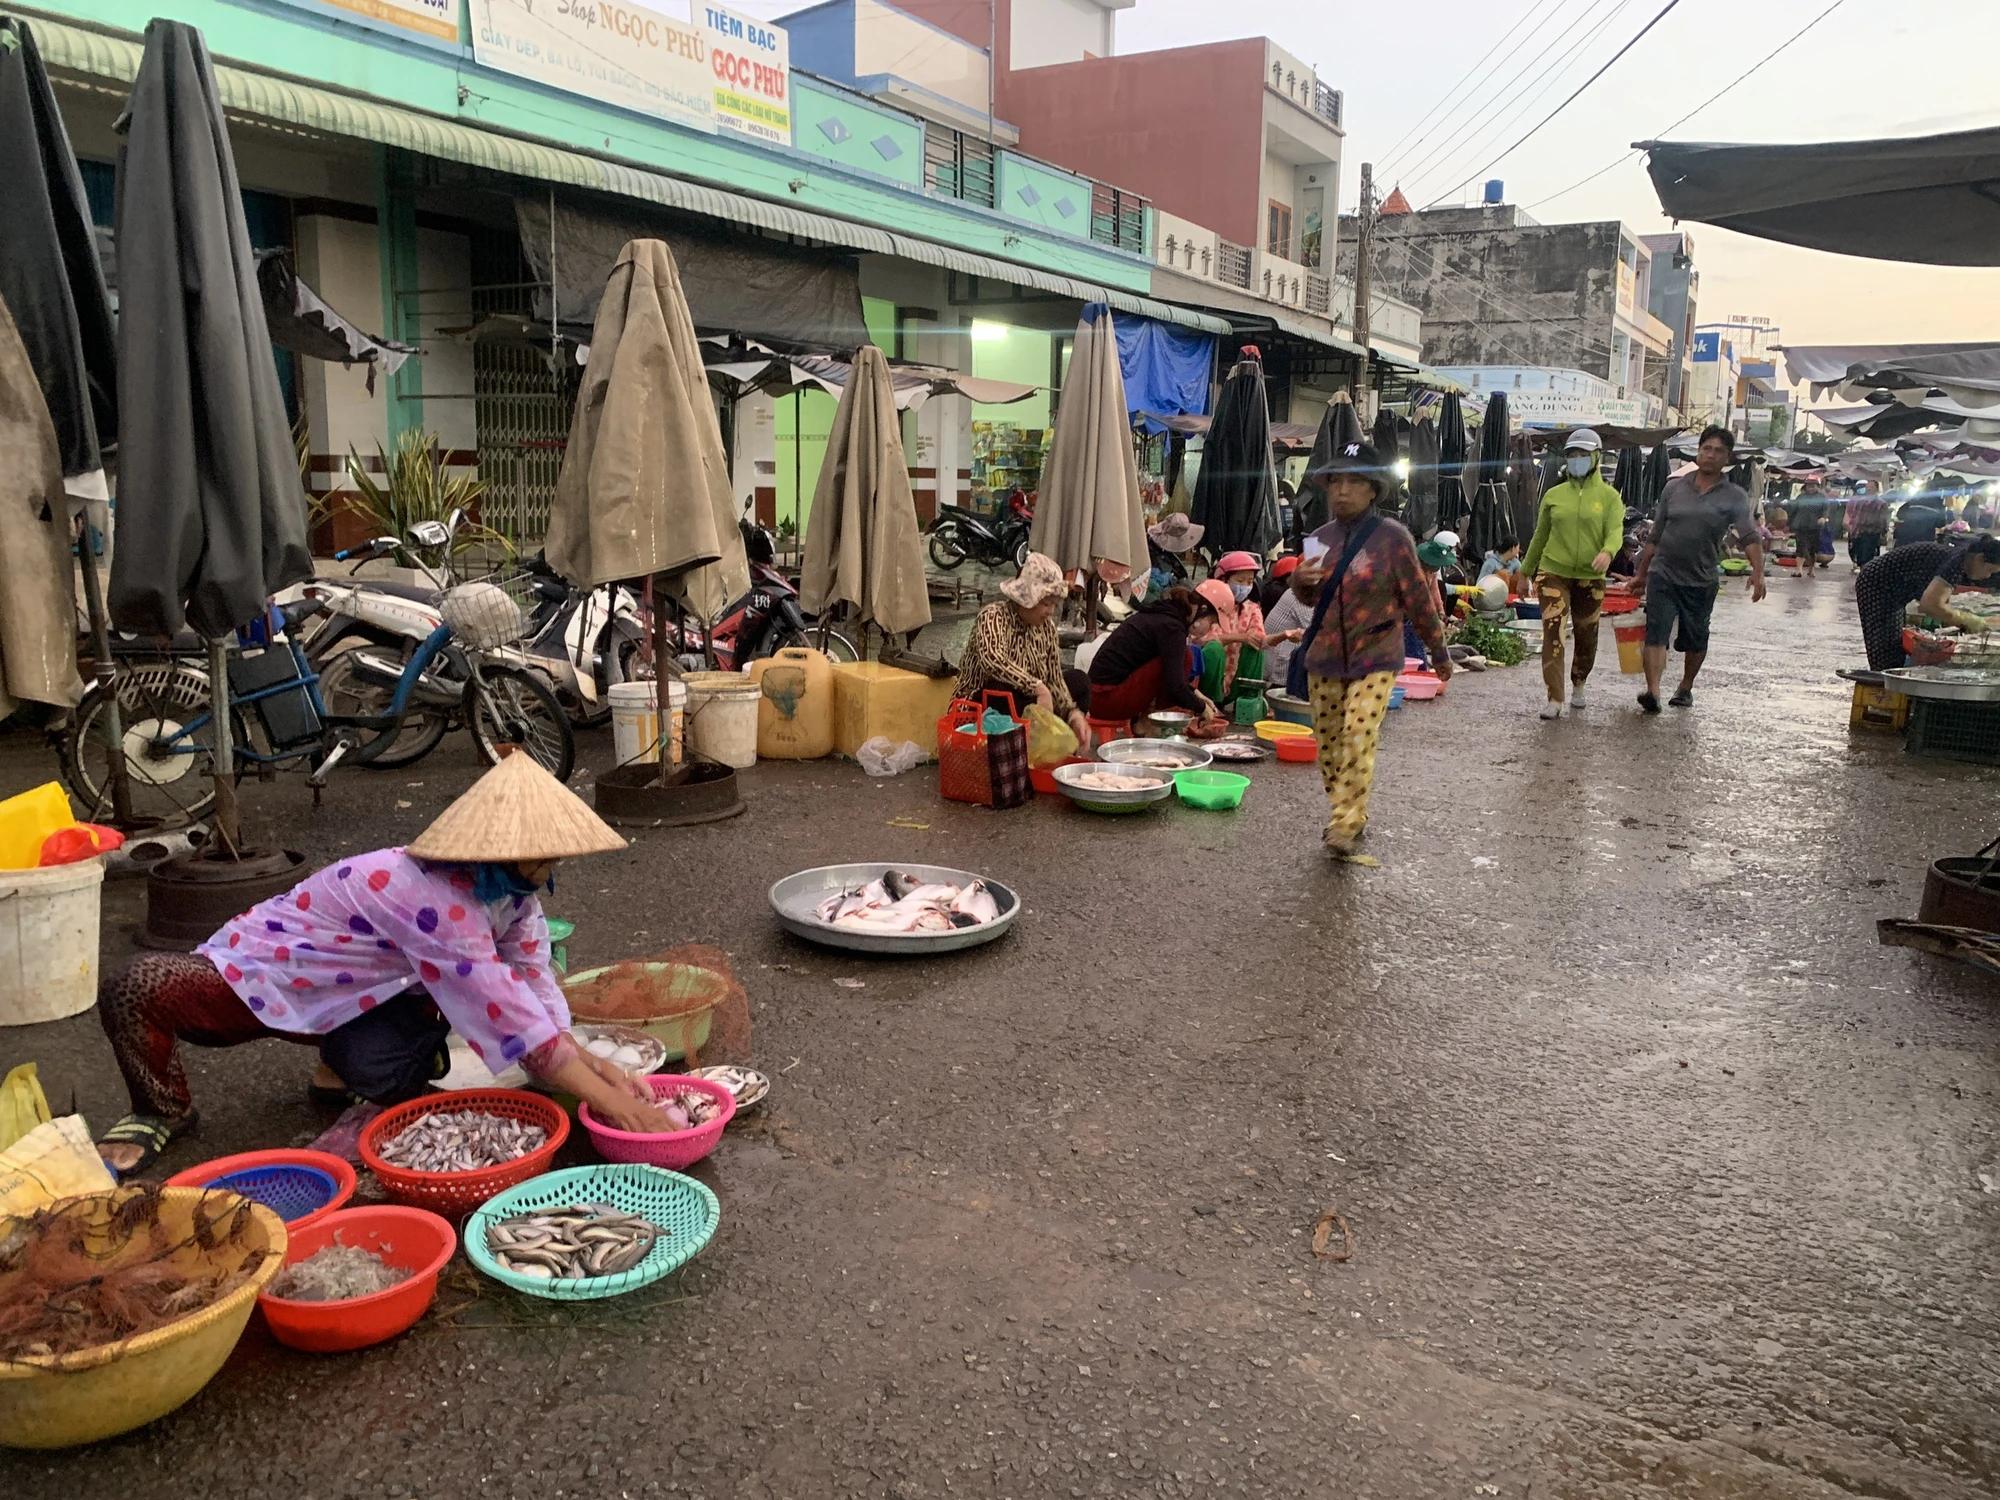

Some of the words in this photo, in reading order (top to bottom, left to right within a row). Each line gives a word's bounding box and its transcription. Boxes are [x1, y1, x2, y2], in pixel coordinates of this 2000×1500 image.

[558, 0, 596, 29] Shop
[598, 1, 659, 48] NGỌC
[665, 27, 705, 63] PHÚ
[705, 7, 743, 39] TIỆM
[748, 24, 776, 51] BẠC
[711, 47, 750, 91] GỌC
[752, 61, 785, 100] PHÚ
[1508, 400, 1539, 411] ÀNG
